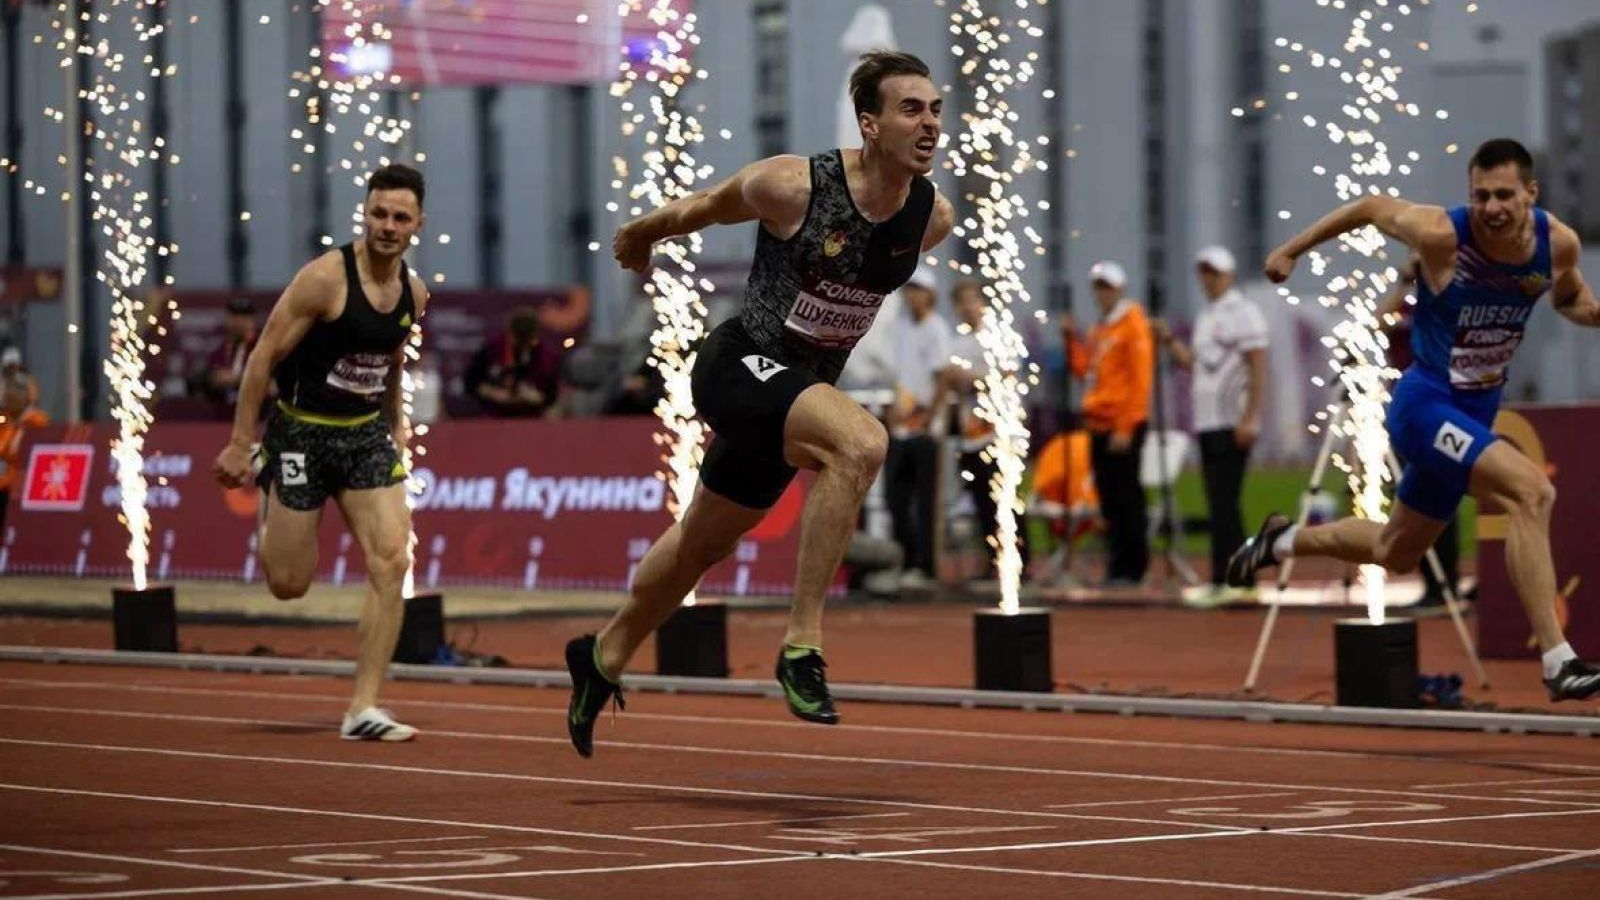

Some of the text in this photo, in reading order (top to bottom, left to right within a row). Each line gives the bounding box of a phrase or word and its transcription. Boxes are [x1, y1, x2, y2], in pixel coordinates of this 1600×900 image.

[757, 357, 776, 373] 4
[1442, 432, 1465, 453] 2
[286, 459, 301, 479] 3
[501, 466, 665, 519] Якунина
